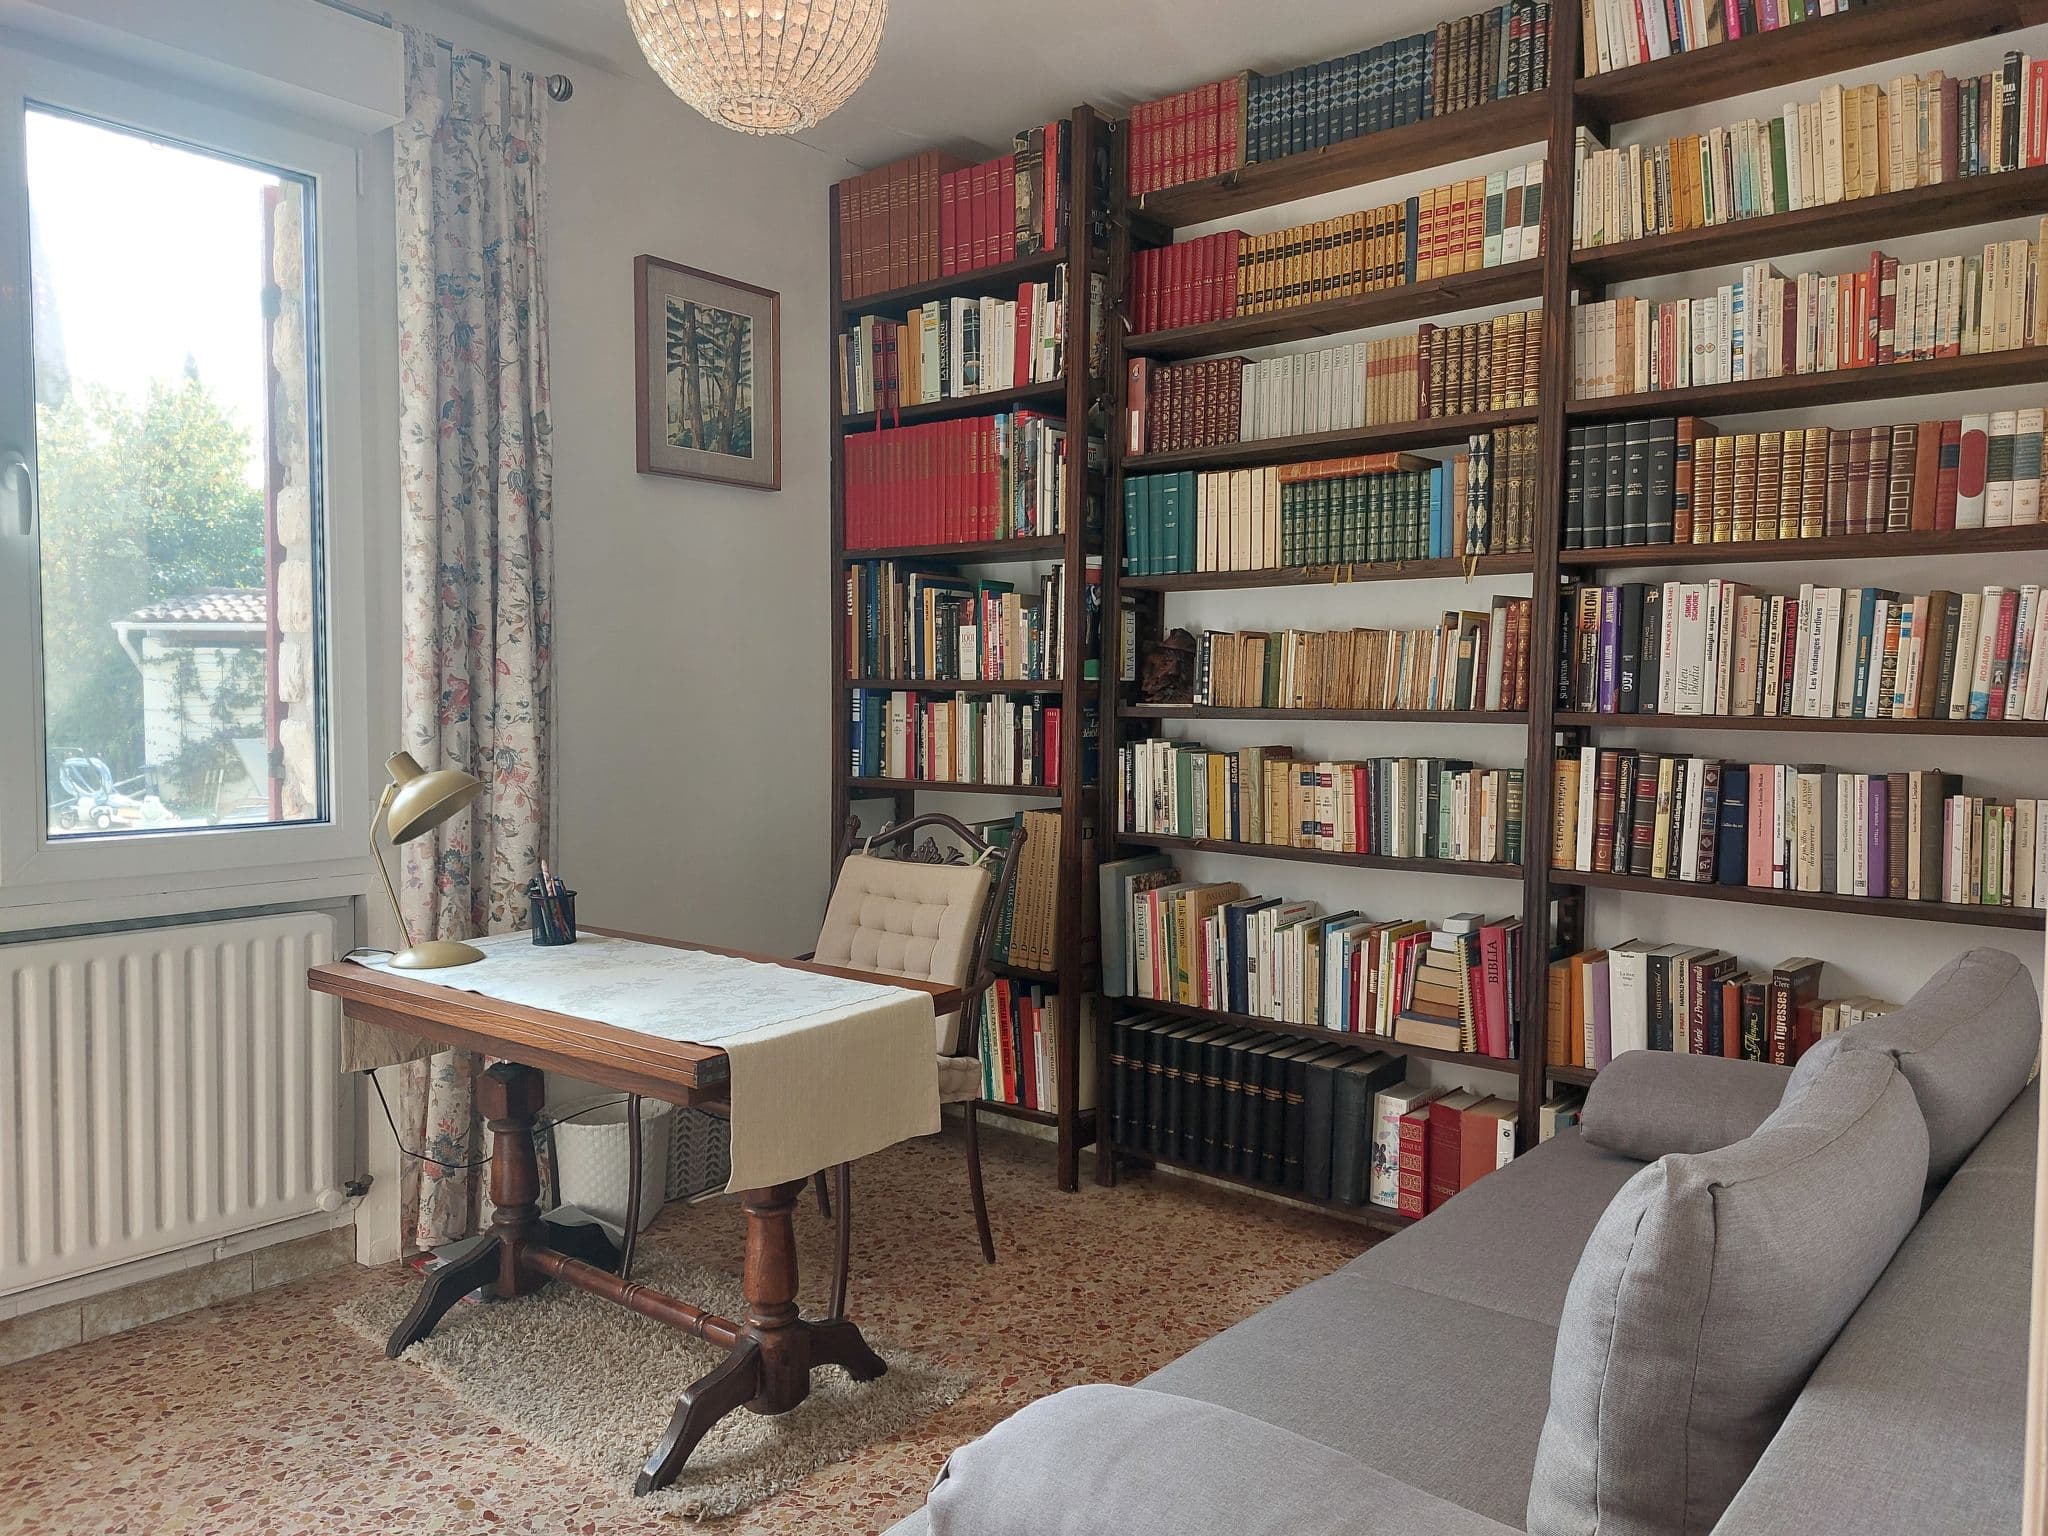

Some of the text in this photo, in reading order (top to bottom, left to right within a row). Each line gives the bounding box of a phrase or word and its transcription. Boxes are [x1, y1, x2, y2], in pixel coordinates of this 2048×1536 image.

[940, 368, 946, 380] LA
[1583, 591, 1598, 630] SHALOM
[1768, 647, 1776, 663] NUIT
[1809, 607, 1822, 690] Les Vendanges tardives
[1979, 636, 1991, 682] ROSAMOND
[1622, 671, 1633, 692] OUT
[2008, 694, 2016, 709] LES
[1556, 819, 1564, 841] TEMPS
[1555, 842, 1562, 852] LE
[1021, 919, 1029, 952] Demeures
[1030, 920, 1039, 953] Demeures
[1043, 922, 1051, 956] Demeures
[1138, 950, 1145, 960] LE
[1487, 940, 1499, 984] BIBLIA
[1774, 980, 1790, 988] Clerc
[1773, 991, 1787, 1040] Tigresses
[1049, 1033, 1053, 1043] du
[1695, 1028, 1703, 1049] Merle
